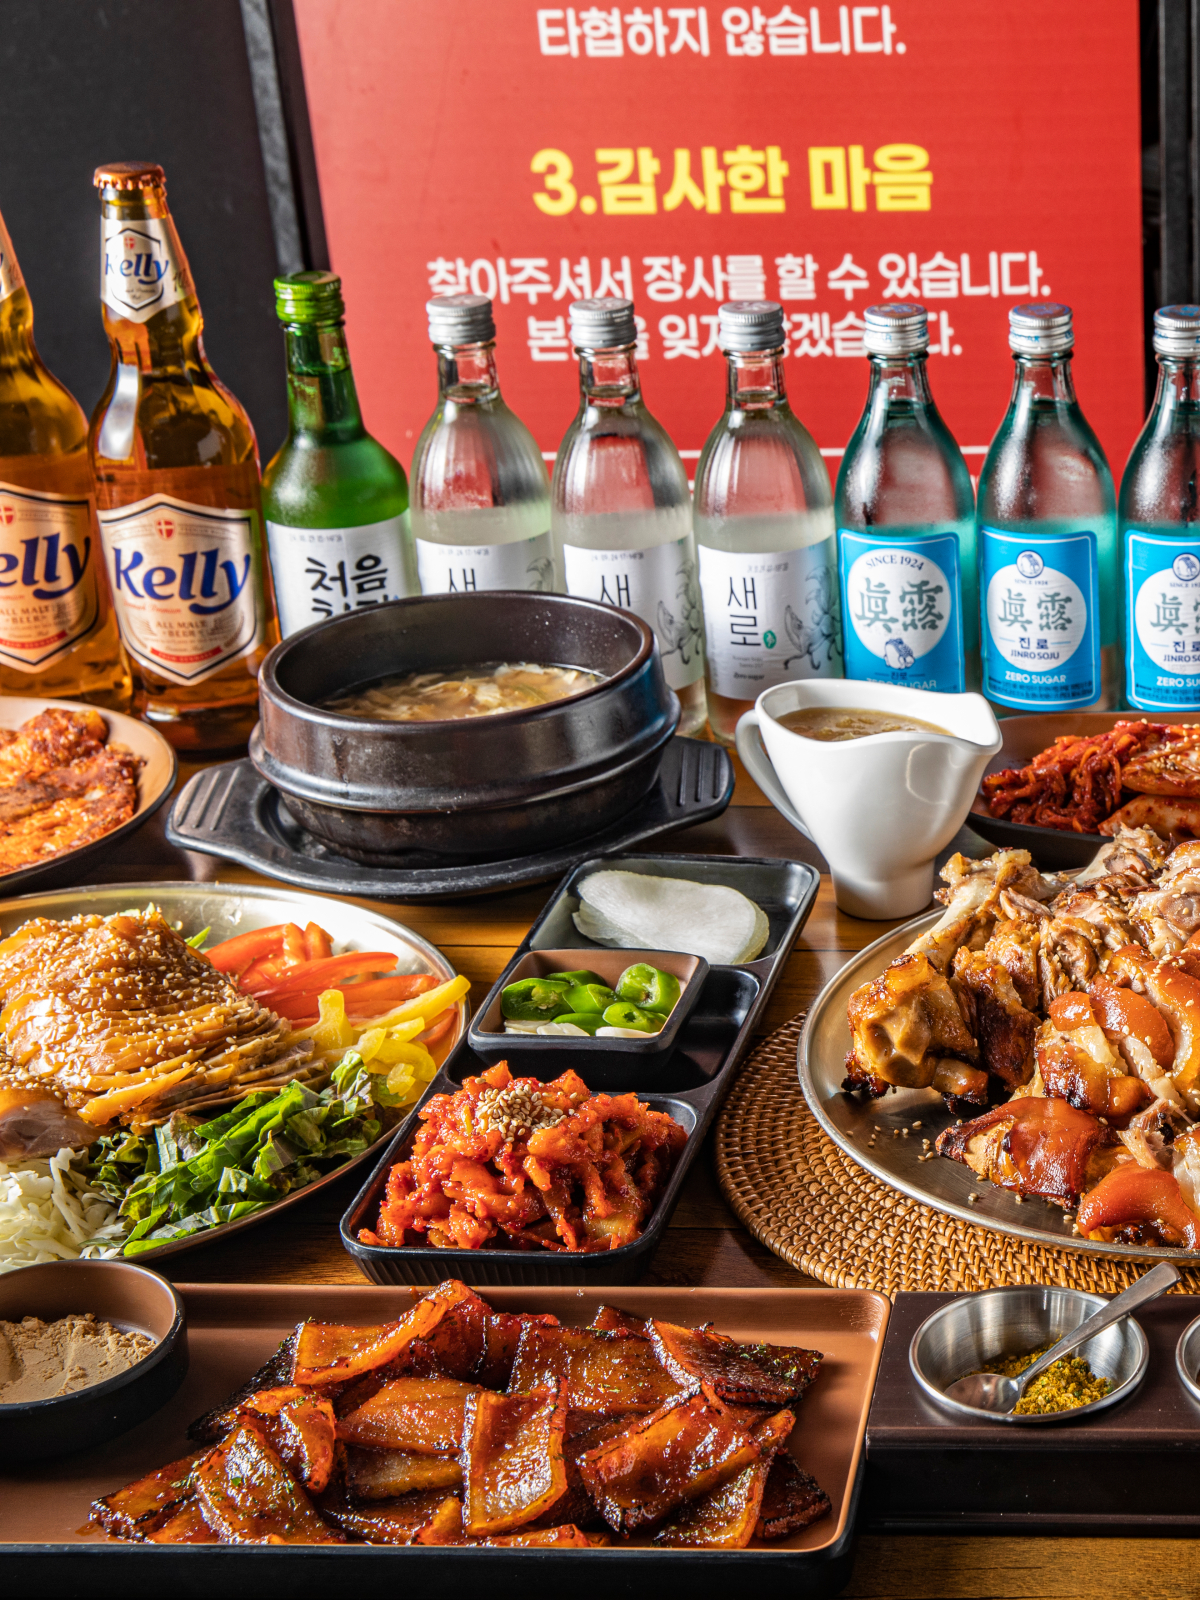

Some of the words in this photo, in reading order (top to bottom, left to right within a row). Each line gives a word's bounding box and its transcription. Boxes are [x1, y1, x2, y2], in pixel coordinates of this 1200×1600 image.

[536, 7, 709, 58] 타협하지
[721, 4, 907, 56] 않습니다.
[529, 146, 790, 217] 3.감사한
[807, 143, 934, 212] 마음
[642, 254, 767, 303] 장사를
[774, 253, 819, 301] 할
[827, 252, 870, 301] 수
[878, 250, 1052, 299] 있습니다.
[783, 310, 963, 358] 겠습다.
[0, 532, 91, 600] elly
[112, 546, 251, 616] Kelly
[304, 553, 388, 598] 처음
[866, 554, 897, 569] SINCE
[900, 556, 924, 571] 1924
[600, 574, 631, 607] 새
[728, 576, 762, 647] 새로
[855, 577, 944, 633] 眞露
[997, 588, 1073, 632] 眞露
[1010, 649, 1037, 660] JINRO
[1037, 651, 1060, 661] SOJU
[1018, 637, 1049, 650] 진로
[1163, 653, 1191, 663] JINRO
[1004, 670, 1031, 683] ZERO
[1031, 674, 1067, 684] SUGAR
[1156, 676, 1185, 688] ZERO
